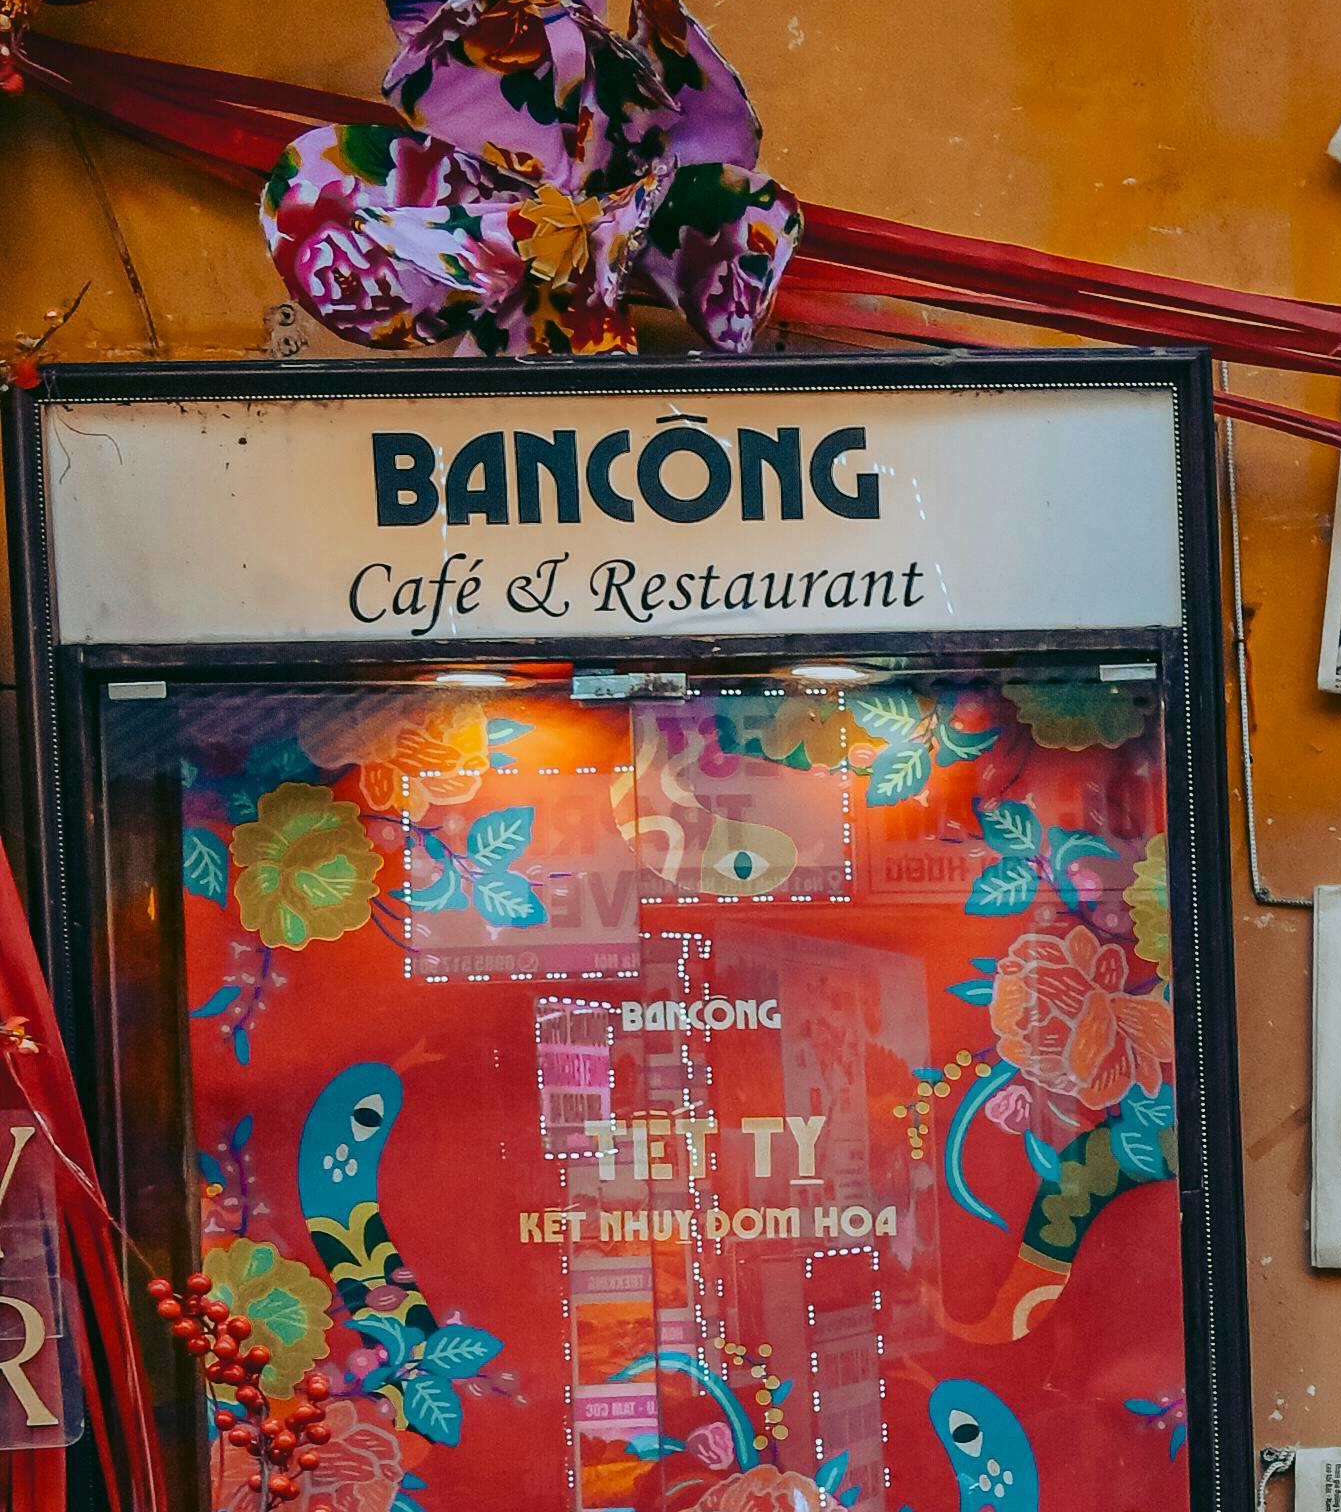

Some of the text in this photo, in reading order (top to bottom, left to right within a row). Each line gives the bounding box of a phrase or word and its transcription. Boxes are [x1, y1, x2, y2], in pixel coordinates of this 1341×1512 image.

[371, 412, 881, 527] BANCÔNG
[349, 551, 925, 636] Café & Restaurant
[621, 993, 783, 1032] BANCÔNG
[584, 1100, 718, 1181] TẾT
[519, 1203, 588, 1244] KẾT
[814, 1205, 898, 1239] HOA
